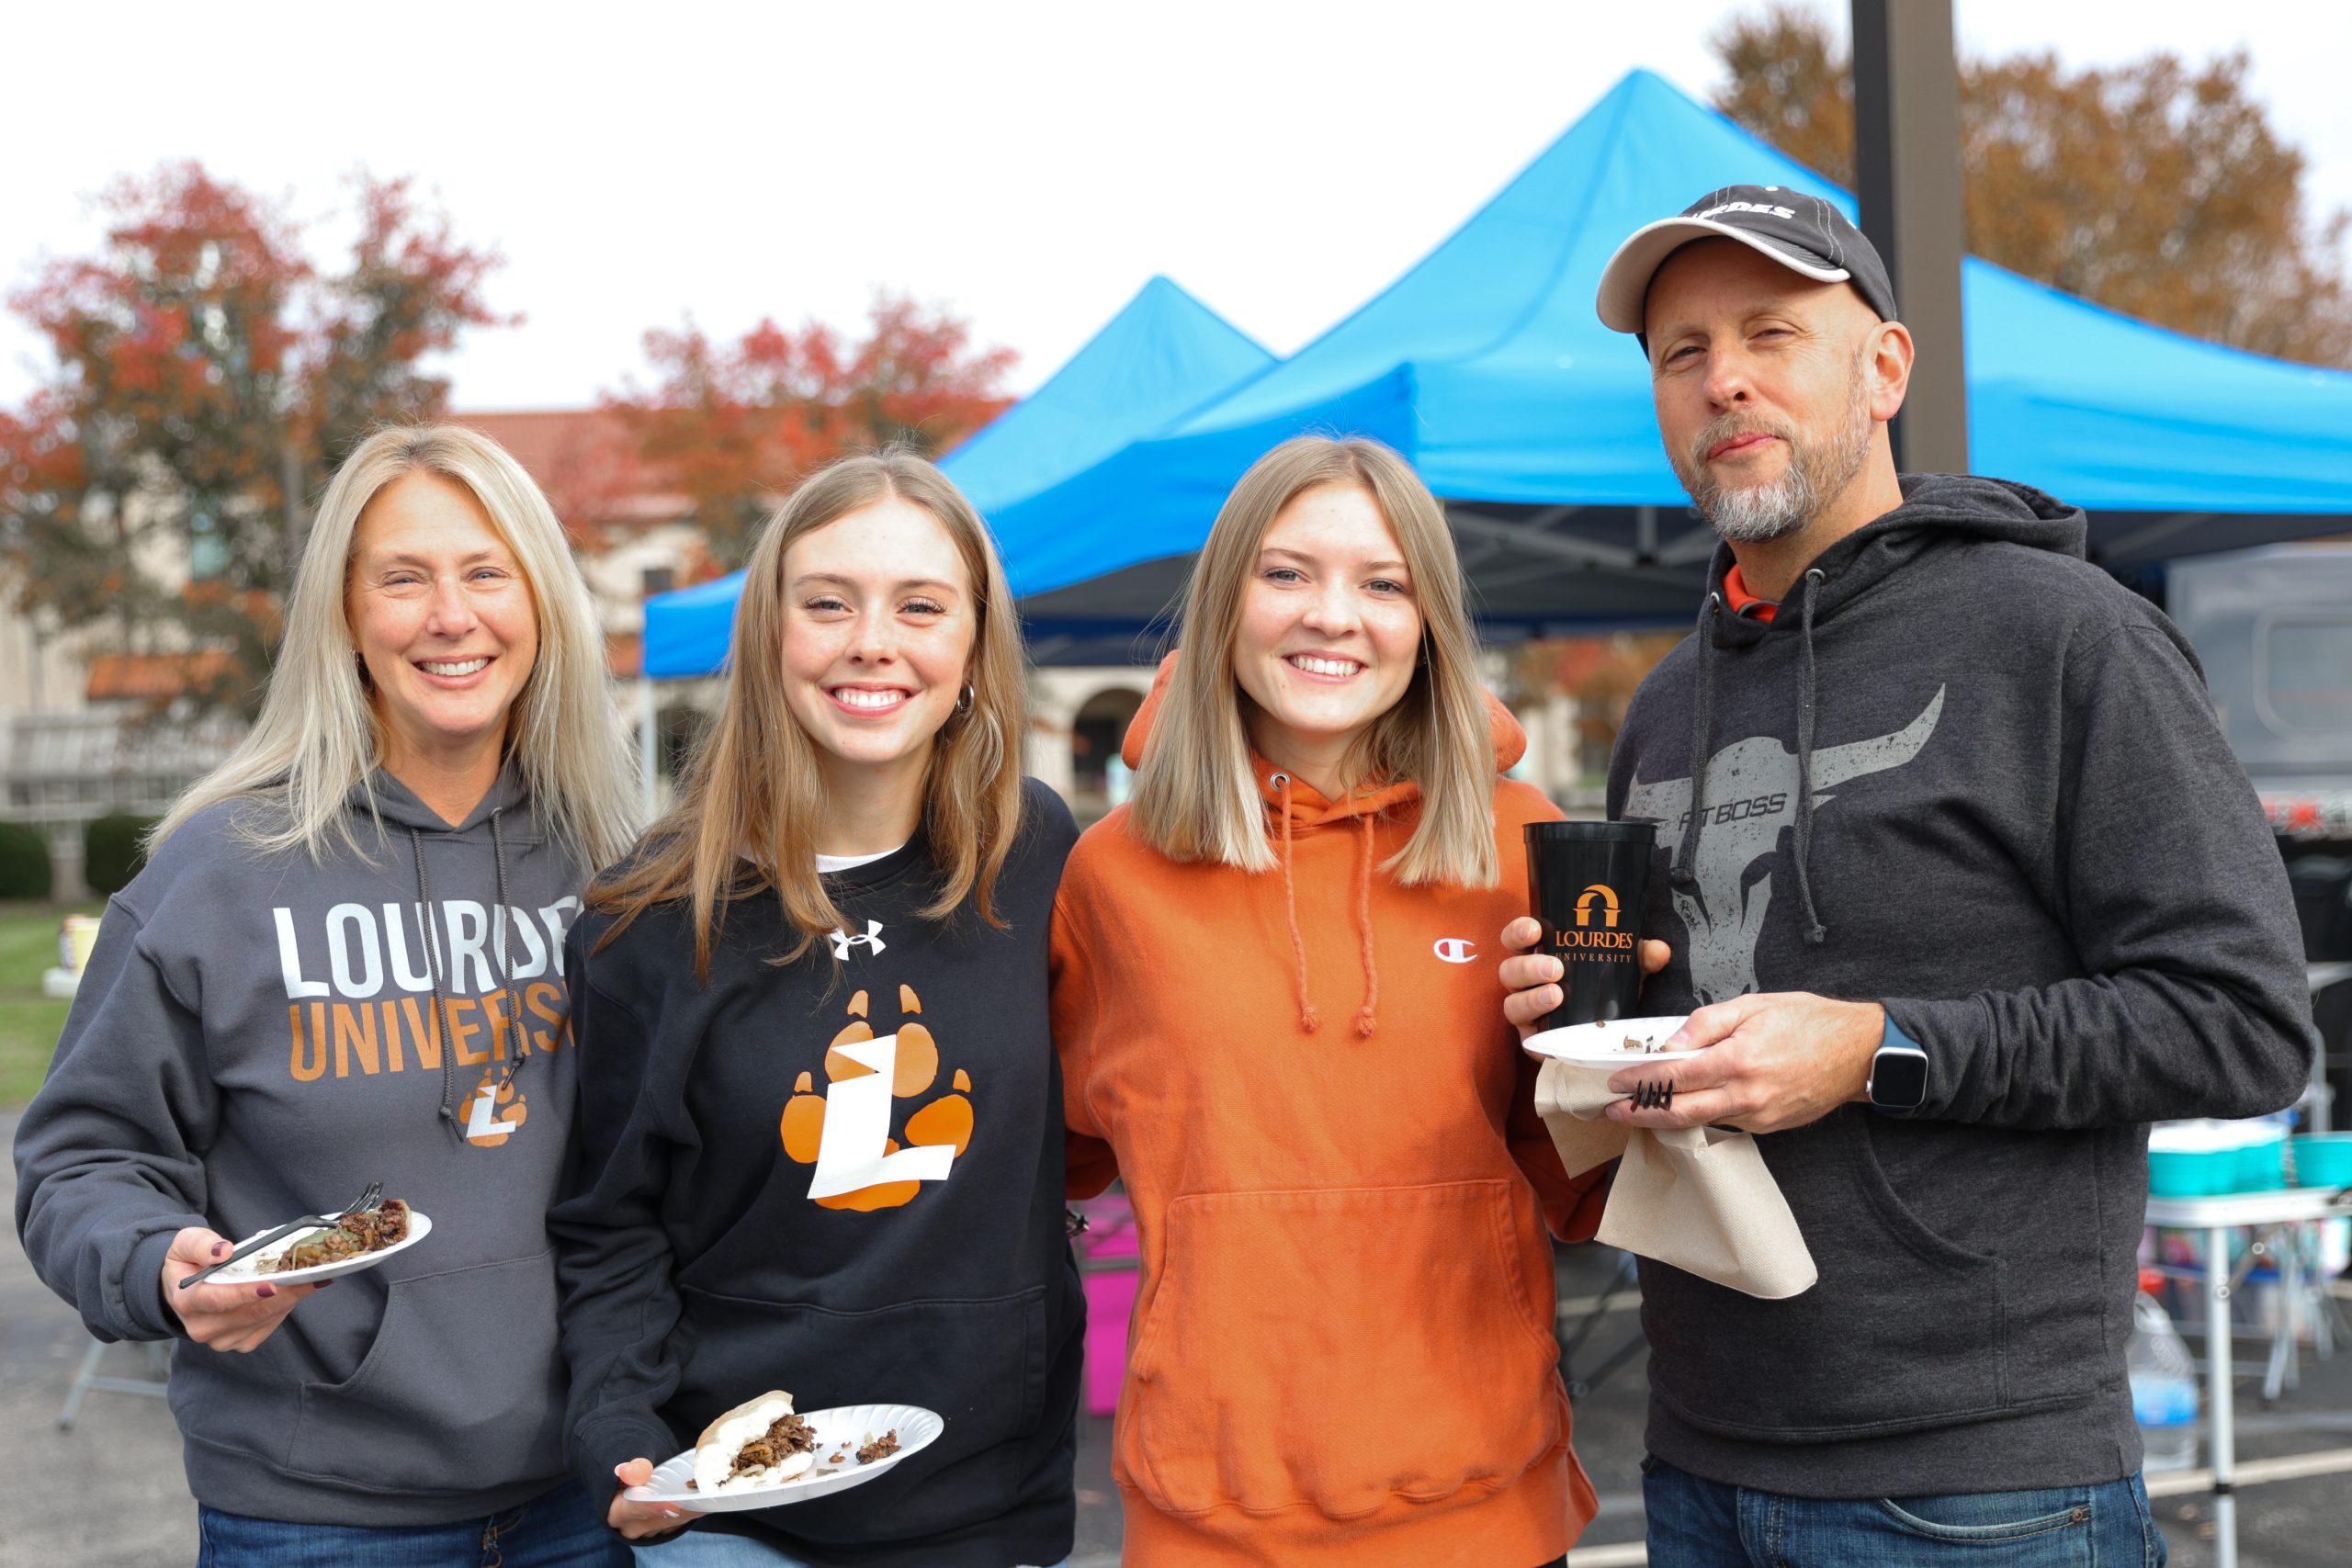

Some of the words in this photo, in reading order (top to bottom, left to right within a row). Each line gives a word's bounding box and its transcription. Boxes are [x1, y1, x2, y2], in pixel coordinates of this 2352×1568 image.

[1691, 202, 1795, 220] RDES
[1715, 793, 1787, 825] BOSS
[273, 896, 585, 998] LOURDE
[1555, 931, 1634, 949] LOURDES
[1555, 953, 1632, 963] UNIVERSITY
